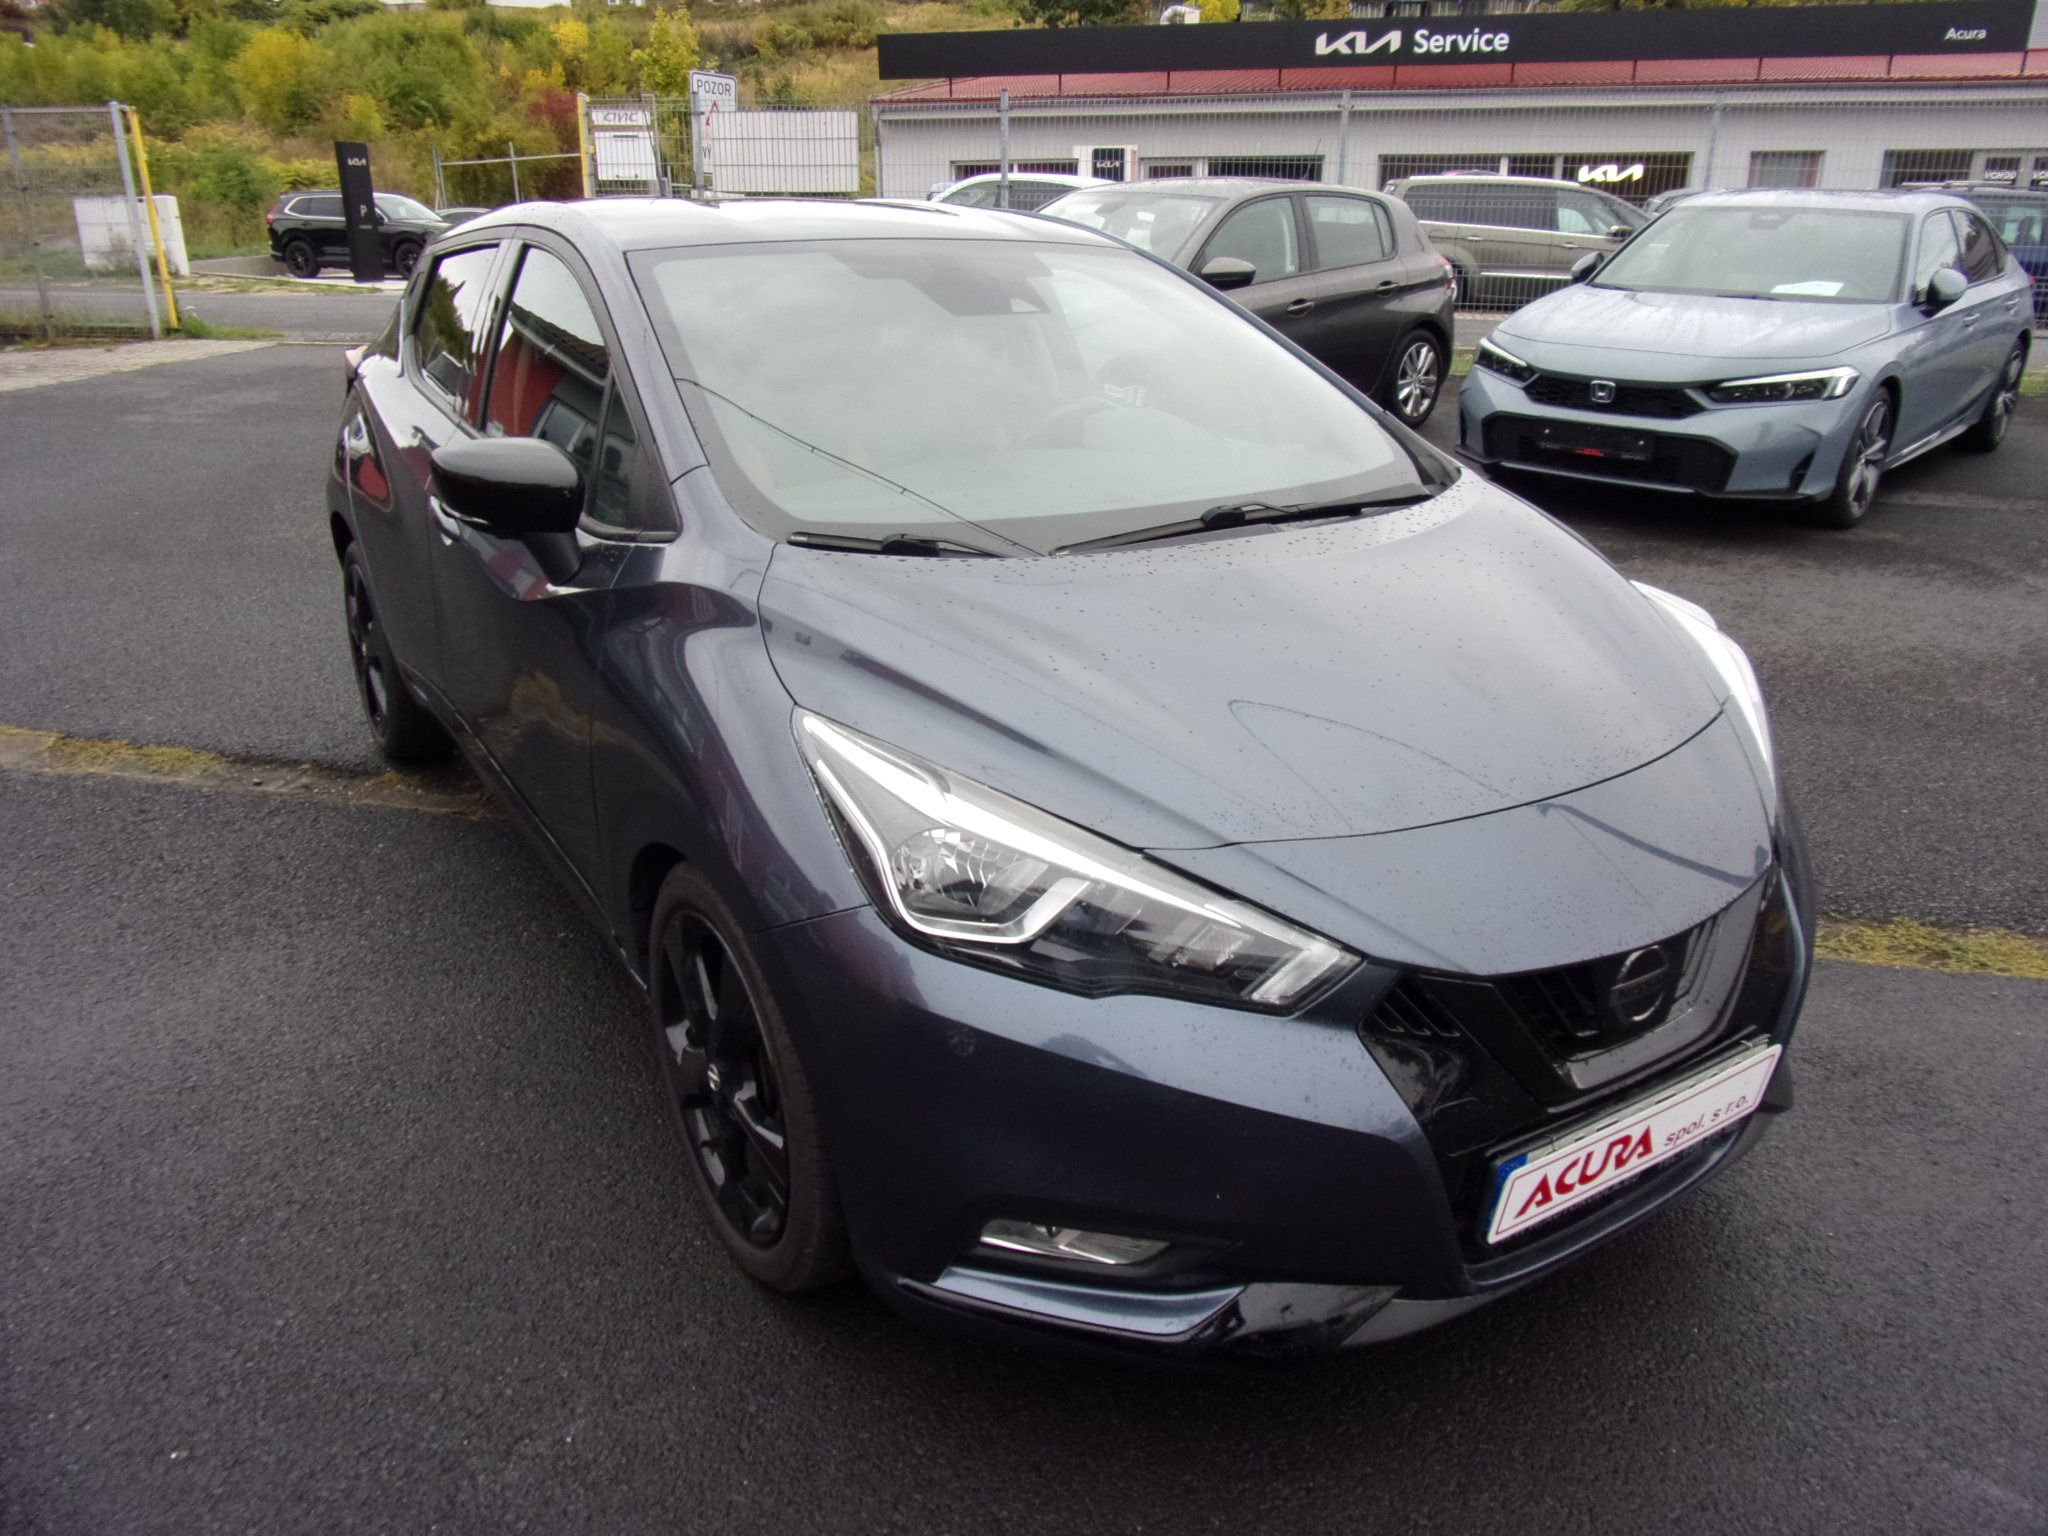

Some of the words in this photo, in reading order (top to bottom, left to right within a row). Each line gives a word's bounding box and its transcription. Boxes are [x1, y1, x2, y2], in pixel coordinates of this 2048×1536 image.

[1315, 31, 1402, 55] KIA
[1413, 28, 1510, 54] Service
[1944, 27, 1986, 41] Acura
[697, 79, 732, 97] POZOR
[1578, 164, 1644, 183] KIA
[1513, 1125, 1654, 1220] ACURA
[1664, 1114, 1704, 1148] spol.
[1711, 1109, 1722, 1123] s
[1726, 1095, 1748, 1117] r.o.
